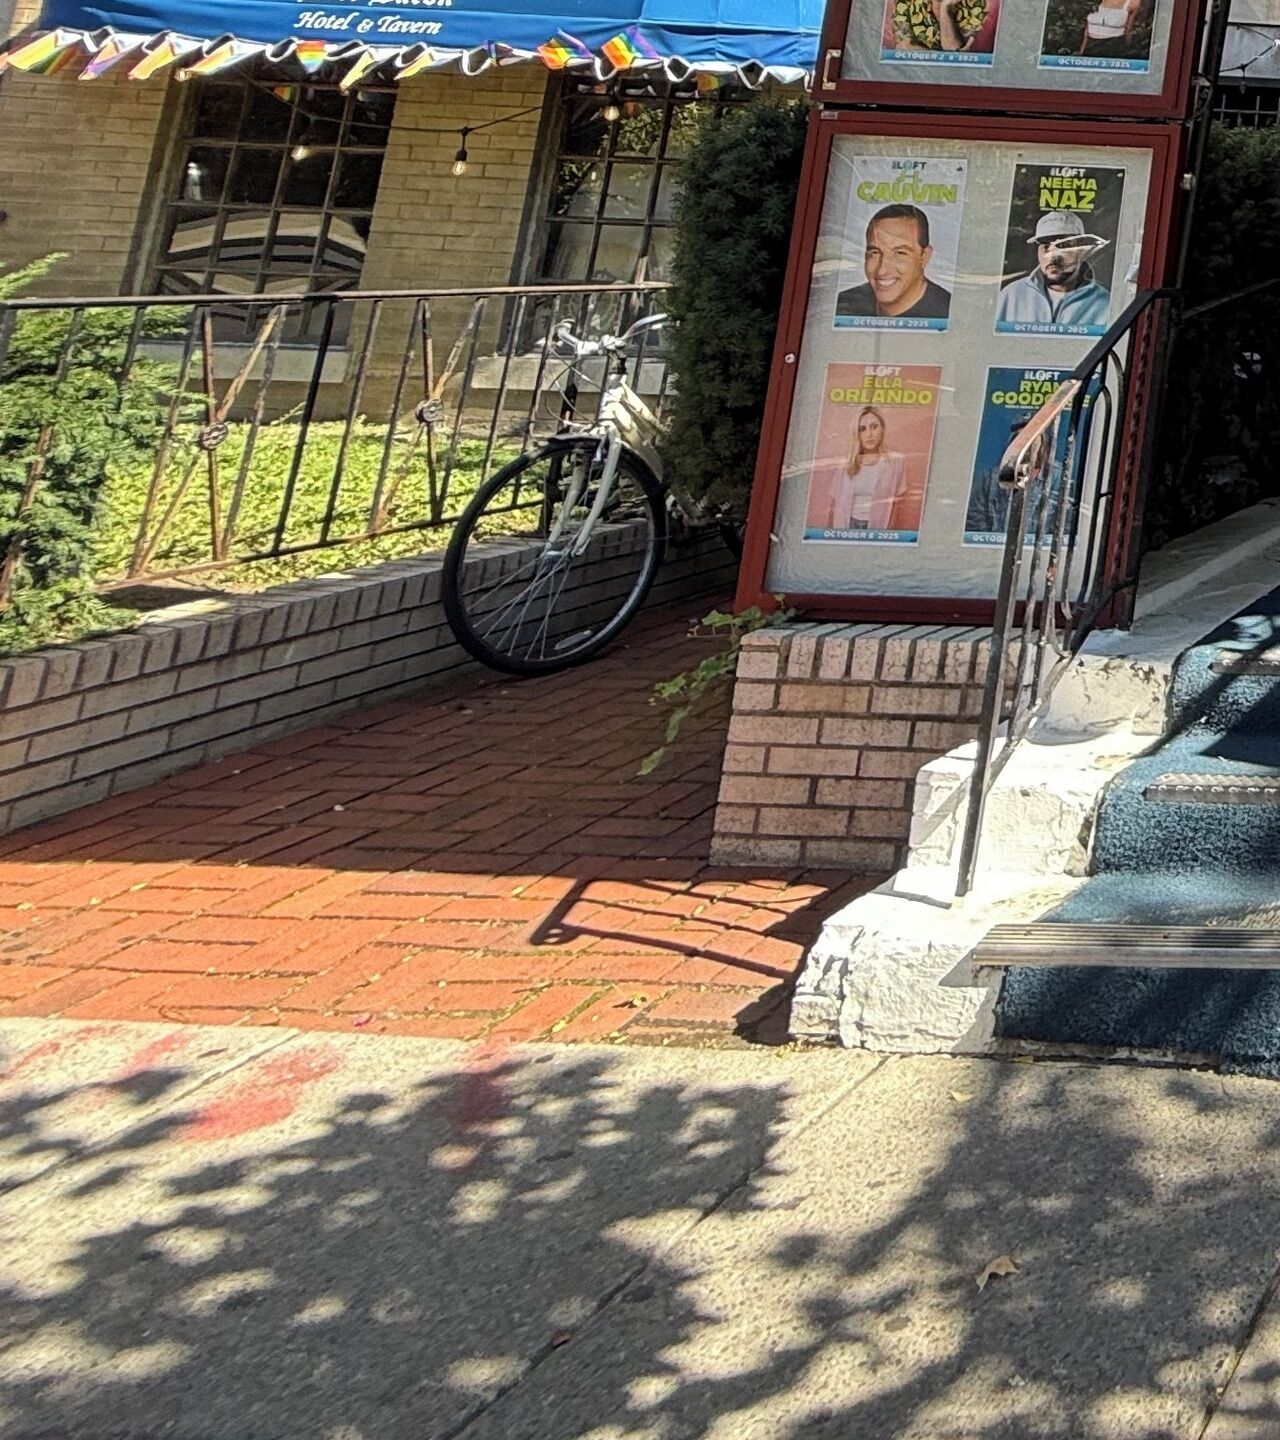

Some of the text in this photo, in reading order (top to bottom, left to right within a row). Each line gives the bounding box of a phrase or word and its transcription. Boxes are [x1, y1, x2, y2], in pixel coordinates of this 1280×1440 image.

[293, 11, 442, 35] Hotel & Tavern
[857, 181, 958, 203] CAUVIN
[1040, 176, 1098, 190] NEEMA
[1040, 189, 1096, 209] NAZ
[863, 376, 903, 388] ELLA
[830, 388, 933, 405] ORLANDO
